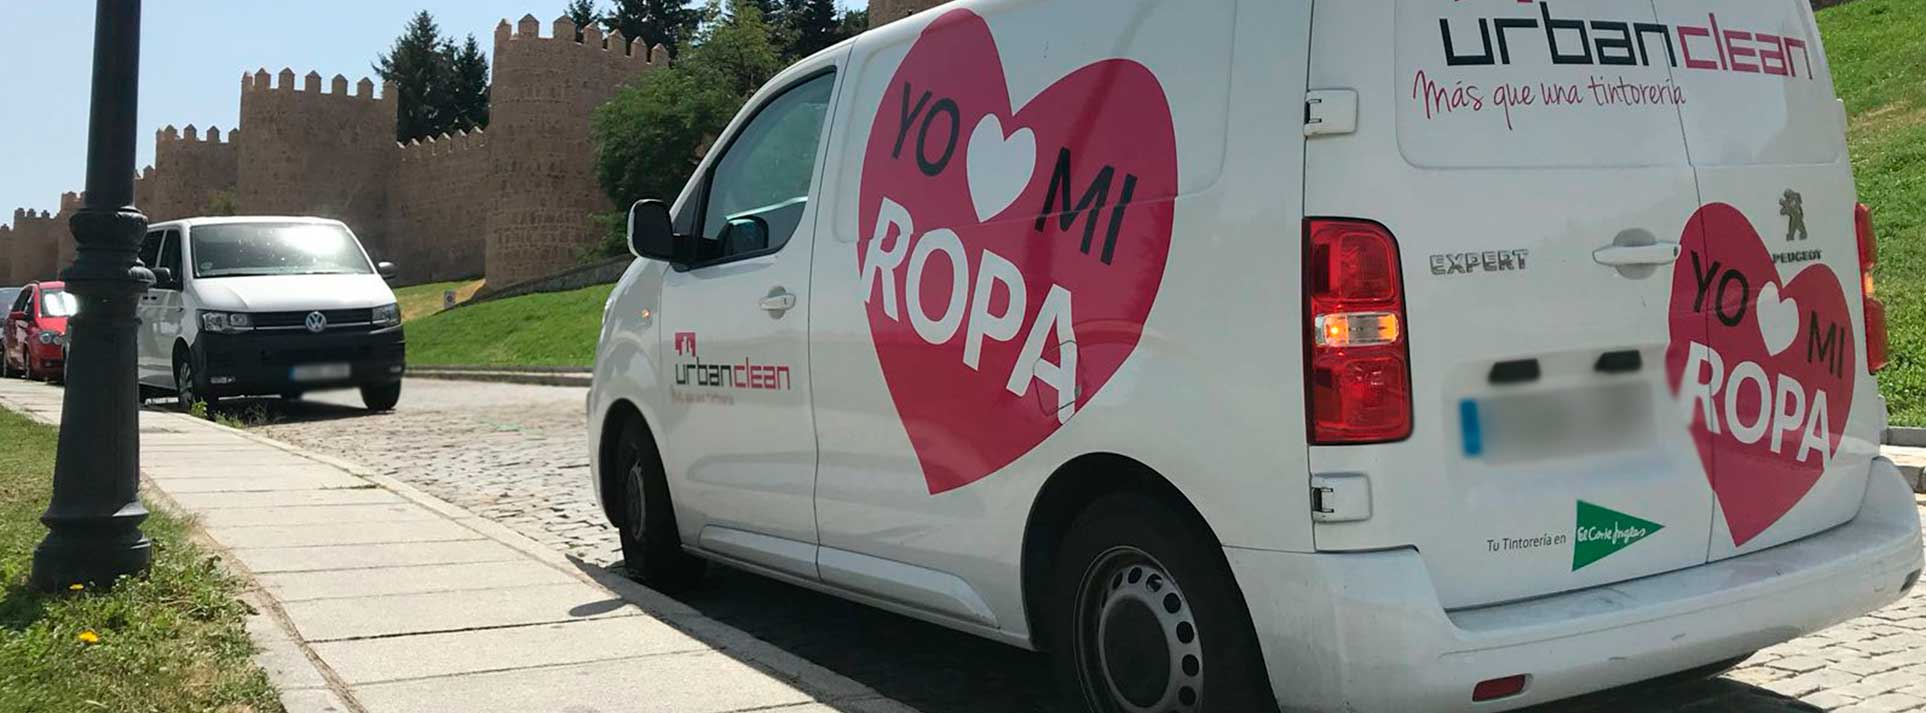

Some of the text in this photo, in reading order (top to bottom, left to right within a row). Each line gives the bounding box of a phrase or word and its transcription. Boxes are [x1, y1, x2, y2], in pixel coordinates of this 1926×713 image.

[1440, 2, 1813, 79] urbanclean
[1413, 70, 1687, 130] Más que una tintorería
[892, 80, 1138, 266] YO MI
[1429, 249, 1529, 275] EXPERT
[1772, 249, 1823, 264] PEUGEOT
[862, 196, 1078, 426] ROPA
[1690, 250, 1846, 379] YO MI
[675, 356, 791, 390] urbanclean
[1683, 340, 1832, 474] ROPA
[1487, 539, 1500, 552] Tu
[1553, 534, 1567, 545] en
[1577, 526, 1588, 542] El
[1588, 526, 1612, 541] Corte
